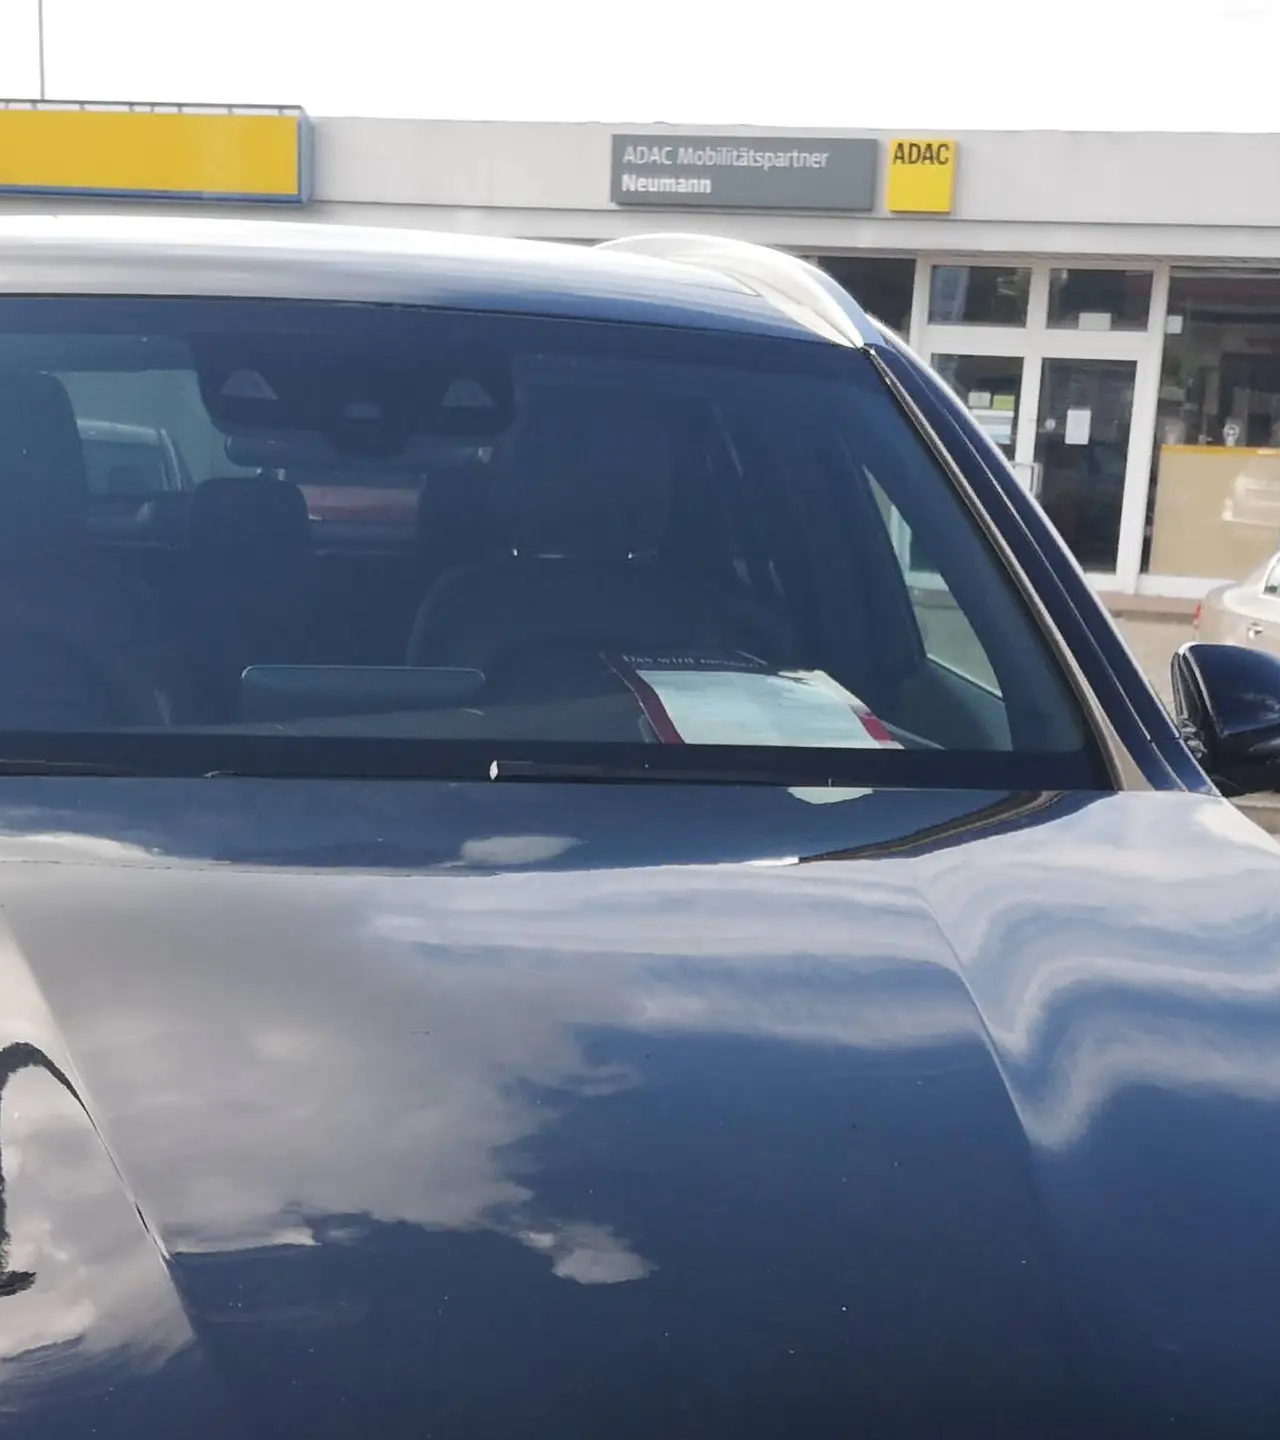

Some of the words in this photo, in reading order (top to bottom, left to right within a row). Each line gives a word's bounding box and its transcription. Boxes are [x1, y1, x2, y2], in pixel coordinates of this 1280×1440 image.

[622, 146, 673, 165] ADAC
[677, 146, 830, 171] Mobilitätspartner
[892, 142, 950, 166] ADAC
[621, 174, 712, 195] Neumann
